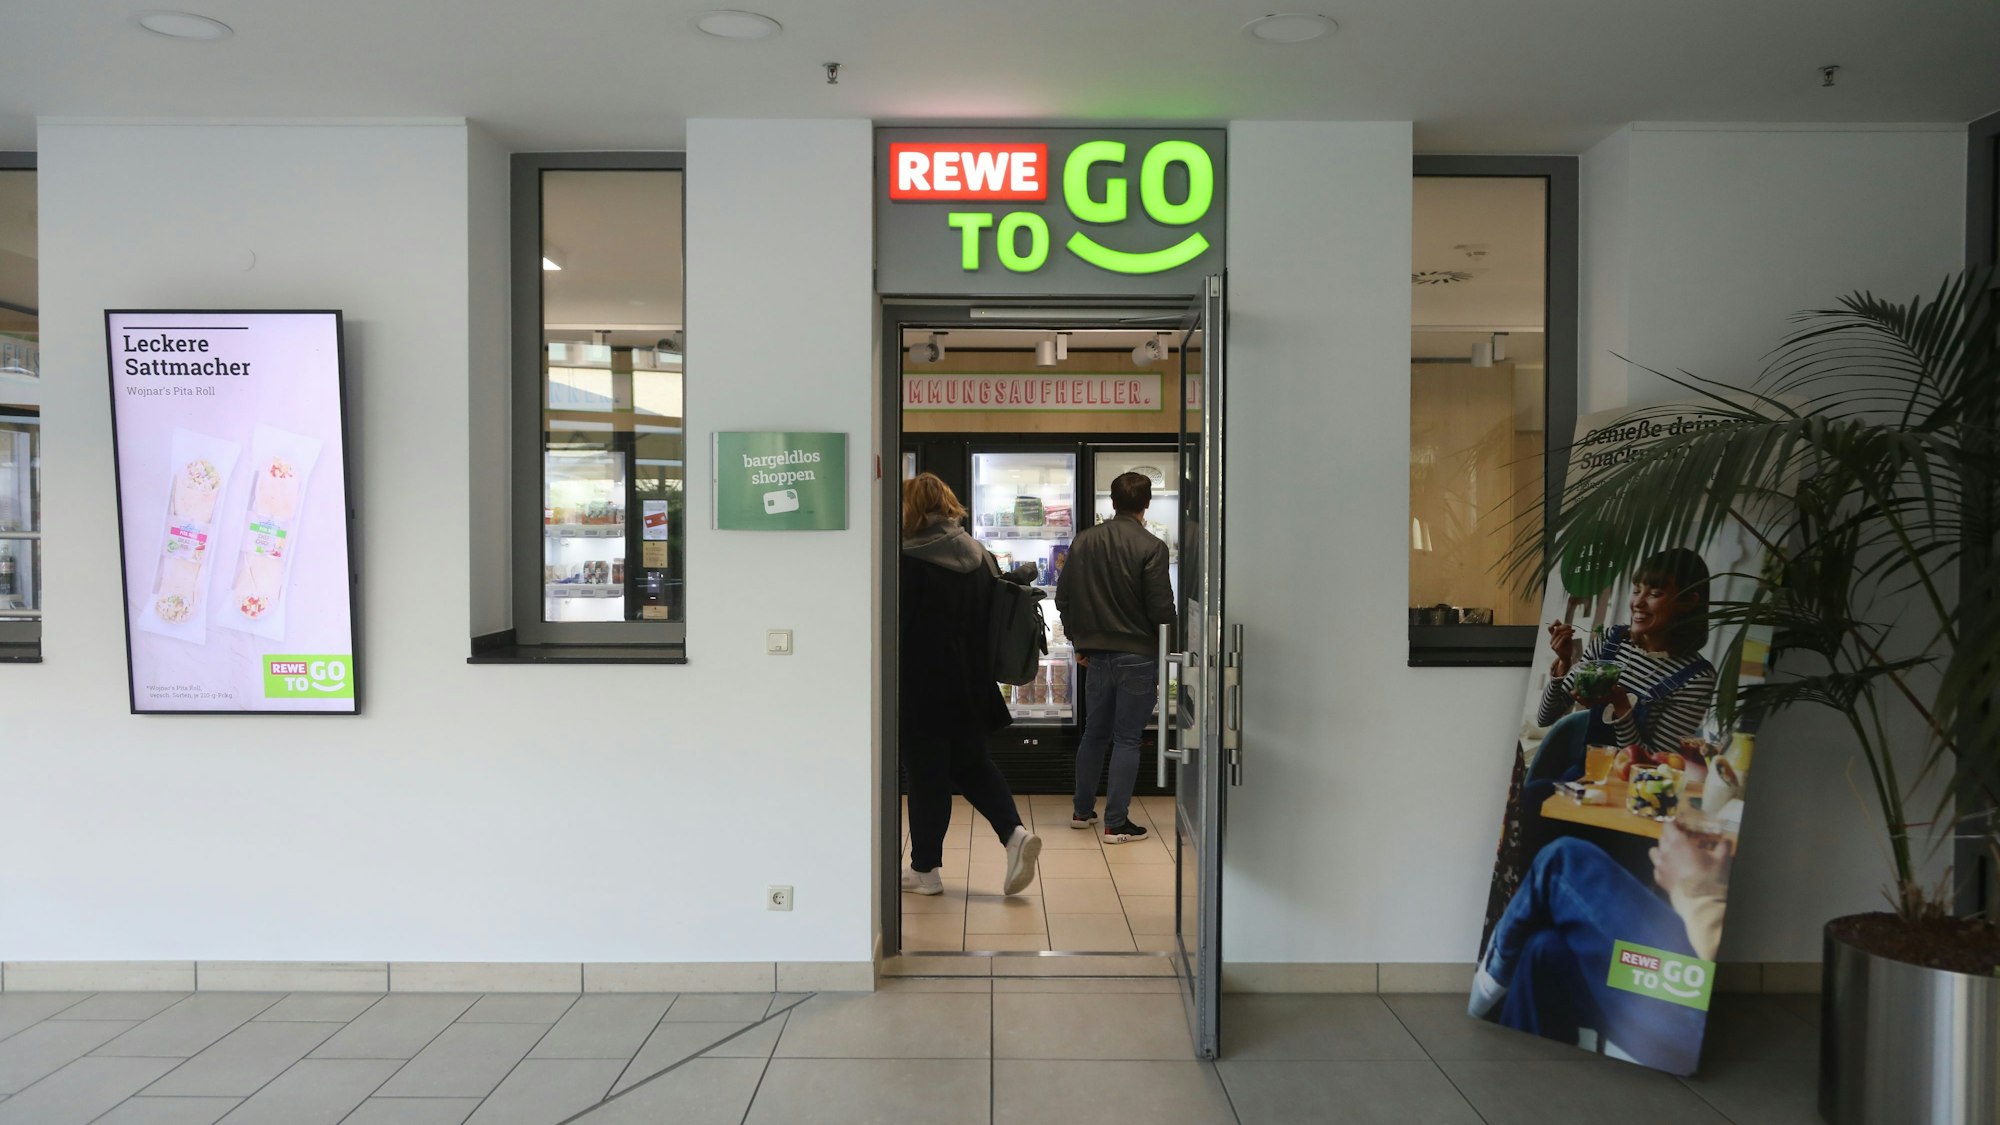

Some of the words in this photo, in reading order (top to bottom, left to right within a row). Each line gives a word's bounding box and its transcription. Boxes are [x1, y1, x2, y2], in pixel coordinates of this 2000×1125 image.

[898, 151, 1039, 191] REWE
[948, 211, 1050, 272] TO
[1062, 140, 1214, 225] GO
[123, 334, 209, 352] Leckere
[125, 358, 250, 376] Sattmacher
[126, 386, 171, 397] Wojnar's
[173, 386, 193, 396] Pita
[196, 386, 215, 396] Roll
[908, 379, 1151, 404] MMUNGSAUFHELLER.
[1586, 420, 1662, 446] Genieße
[742, 449, 820, 469] bargeldlos
[751, 469, 816, 486] shoppen
[272, 663, 306, 673] REWE
[285, 677, 308, 691] TO
[310, 660, 346, 681] GO
[1621, 951, 1659, 970] REWE
[1632, 969, 1659, 989] TO
[1662, 960, 1705, 987] GO
